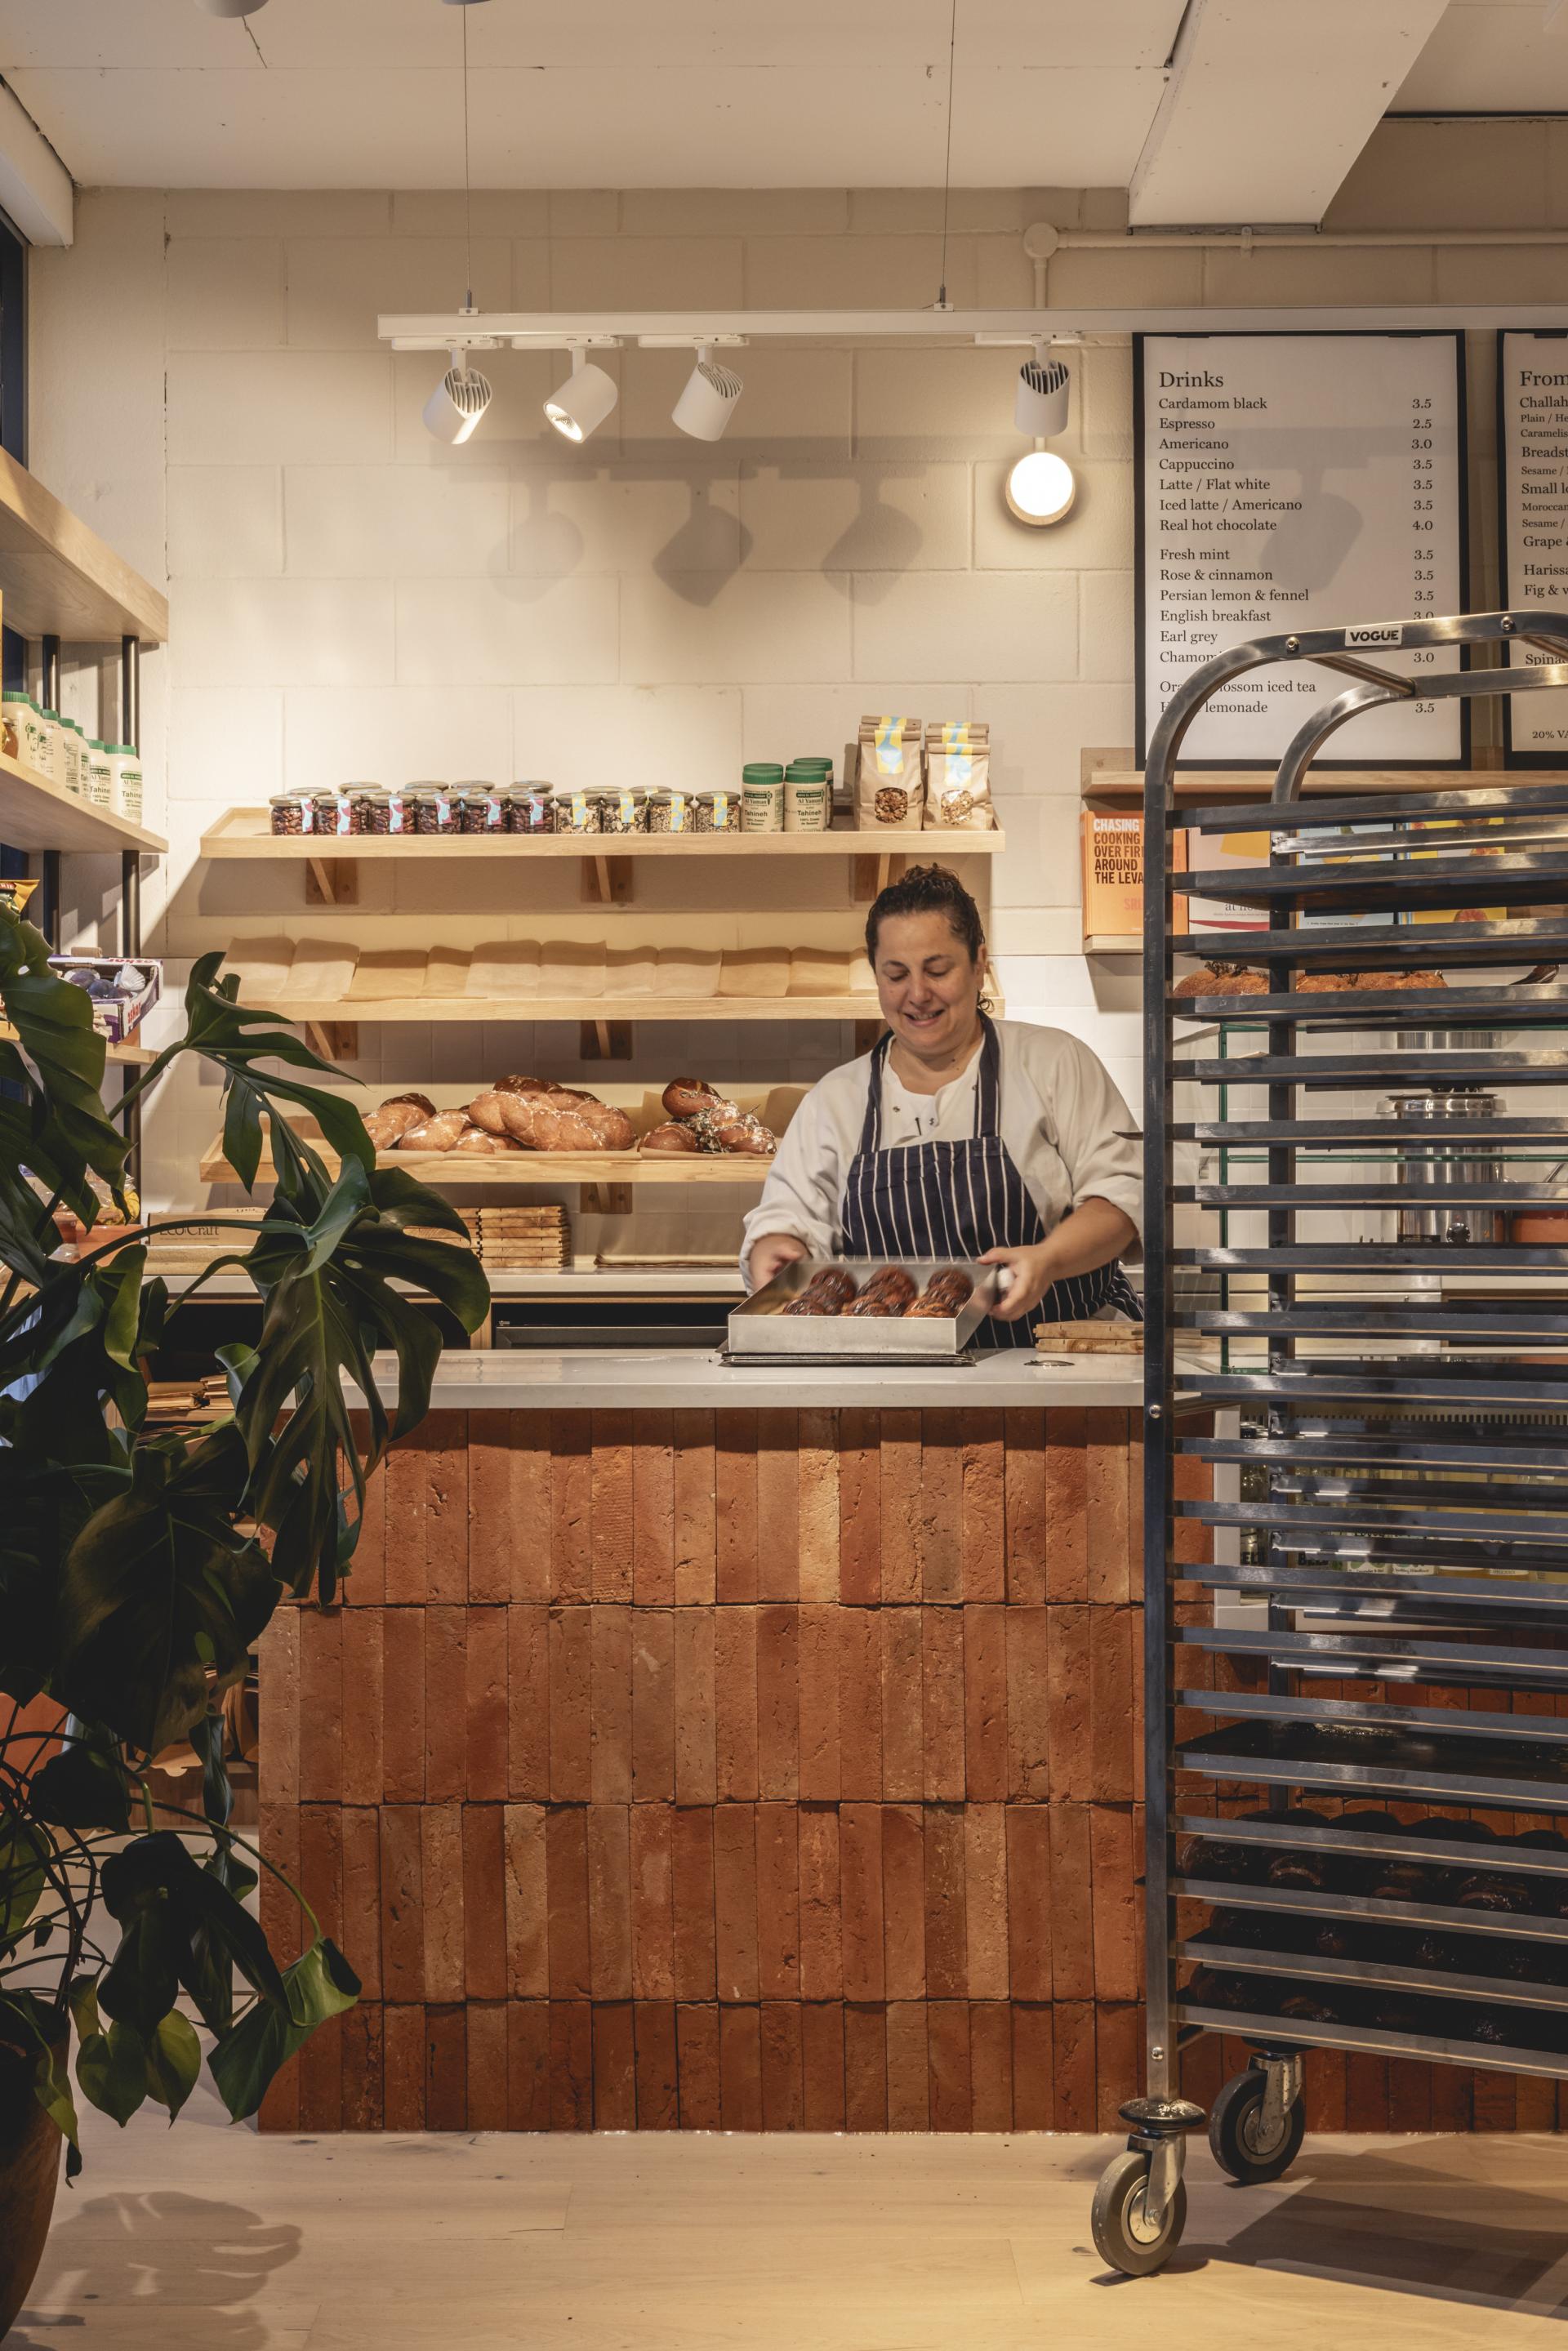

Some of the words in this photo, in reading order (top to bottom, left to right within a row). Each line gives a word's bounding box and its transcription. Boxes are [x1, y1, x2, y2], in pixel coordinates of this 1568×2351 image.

[1159, 371, 1223, 387] Drinks
[1520, 371, 1568, 386] From
[1159, 397, 1229, 409] Cardamom
[1233, 397, 1267, 408] black
[1412, 399, 1431, 408] 3.5
[1520, 395, 1568, 407] Challah
[1521, 414, 1545, 422] Plain
[1160, 418, 1215, 431] Espresso
[1413, 419, 1432, 429] 2.5
[1521, 429, 1568, 438] Caramelis
[1159, 438, 1228, 449] Americano
[1412, 439, 1432, 449] 3.0
[1159, 458, 1234, 473] Cappuccino
[1413, 459, 1432, 470] 3.5
[1521, 466, 1557, 474] Sesame
[1160, 479, 1192, 490] Latte
[1196, 478, 1201, 492] /
[1206, 478, 1231, 489] Flat
[1235, 479, 1270, 489] white
[1414, 479, 1432, 490] 3.5
[1522, 483, 1557, 494] Small
[1160, 498, 1187, 510] Iced
[1190, 499, 1219, 510] latte
[1223, 498, 1228, 513] /
[1232, 499, 1302, 510] Americano
[1414, 501, 1432, 510] 3.5
[1160, 519, 1188, 531] Real
[1192, 519, 1213, 530] hot
[1217, 519, 1276, 530] chocolate
[1413, 521, 1432, 530] 4.0
[1522, 519, 1558, 528] Sesame
[1523, 536, 1562, 549] Grape
[1160, 548, 1196, 560] Fresh
[1200, 549, 1230, 559] mint
[1414, 550, 1433, 559] 3.5
[1160, 569, 1191, 581] Rose
[1194, 569, 1205, 581] &
[1209, 569, 1272, 580] cinnamon
[1414, 570, 1433, 580] 3.5
[1160, 590, 1207, 600] Persian
[1211, 589, 1251, 601] lemon
[1255, 590, 1266, 600] &
[1269, 589, 1308, 601] fennel
[1414, 590, 1433, 601] 3.5
[1524, 585, 1545, 598] Fig
[1548, 585, 1559, 595] &
[1160, 609, 1208, 624] English
[1212, 609, 1271, 621] breakfast
[1414, 611, 1434, 619] 30
[1160, 630, 1187, 642] Earl
[1190, 634, 1218, 645] grey
[1350, 630, 1399, 642] VOGUE
[1414, 652, 1434, 662] 3.0
[1160, 681, 1183, 692] Ora
[1219, 683, 1263, 692] ossom
[1267, 679, 1293, 692] iced
[1297, 682, 1316, 692] tea
[1205, 701, 1267, 713] lemonade
[1415, 703, 1434, 713] 3.5
[1532, 731, 1555, 739] 20%
[1094, 819, 1139, 832] CHASING
[1094, 833, 1140, 844] COOKING
[1094, 846, 1121, 857] OVER
[1095, 859, 1138, 870] AROUND
[1094, 872, 1115, 884] THE
[1119, 872, 1143, 884] LEVA
